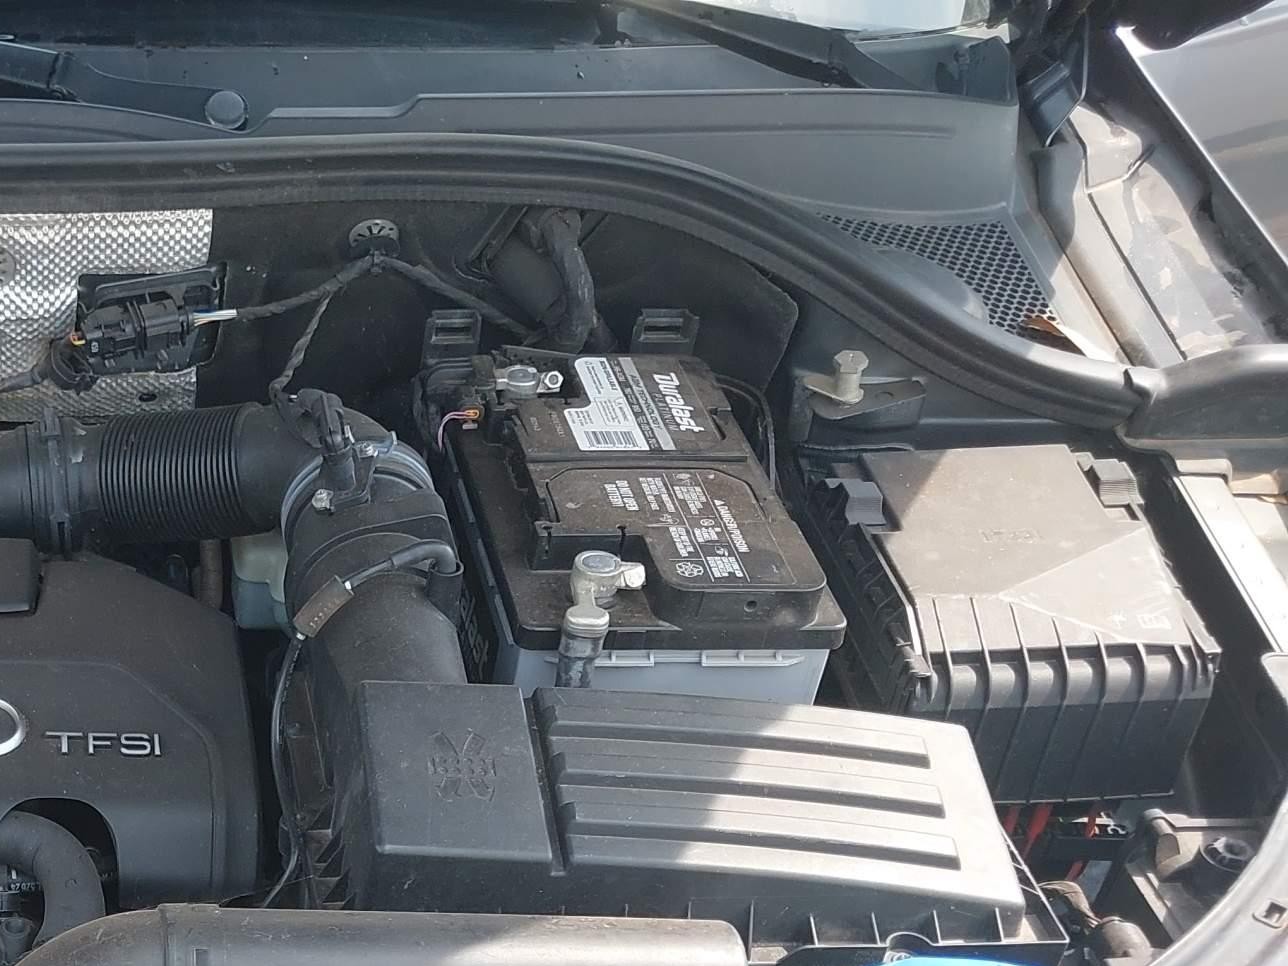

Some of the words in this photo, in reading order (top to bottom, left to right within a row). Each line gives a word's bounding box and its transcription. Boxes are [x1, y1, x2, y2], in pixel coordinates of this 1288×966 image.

[636, 389, 662, 430] TECHNOLOGY
[652, 372, 705, 433] Duralast
[652, 393, 680, 432] PLATINUM
[615, 480, 629, 488] DO
[619, 487, 633, 498] NOT
[623, 497, 640, 511] OPEN
[716, 505, 751, 553] DANGER/POISON
[44, 730, 162, 756] TFSI
